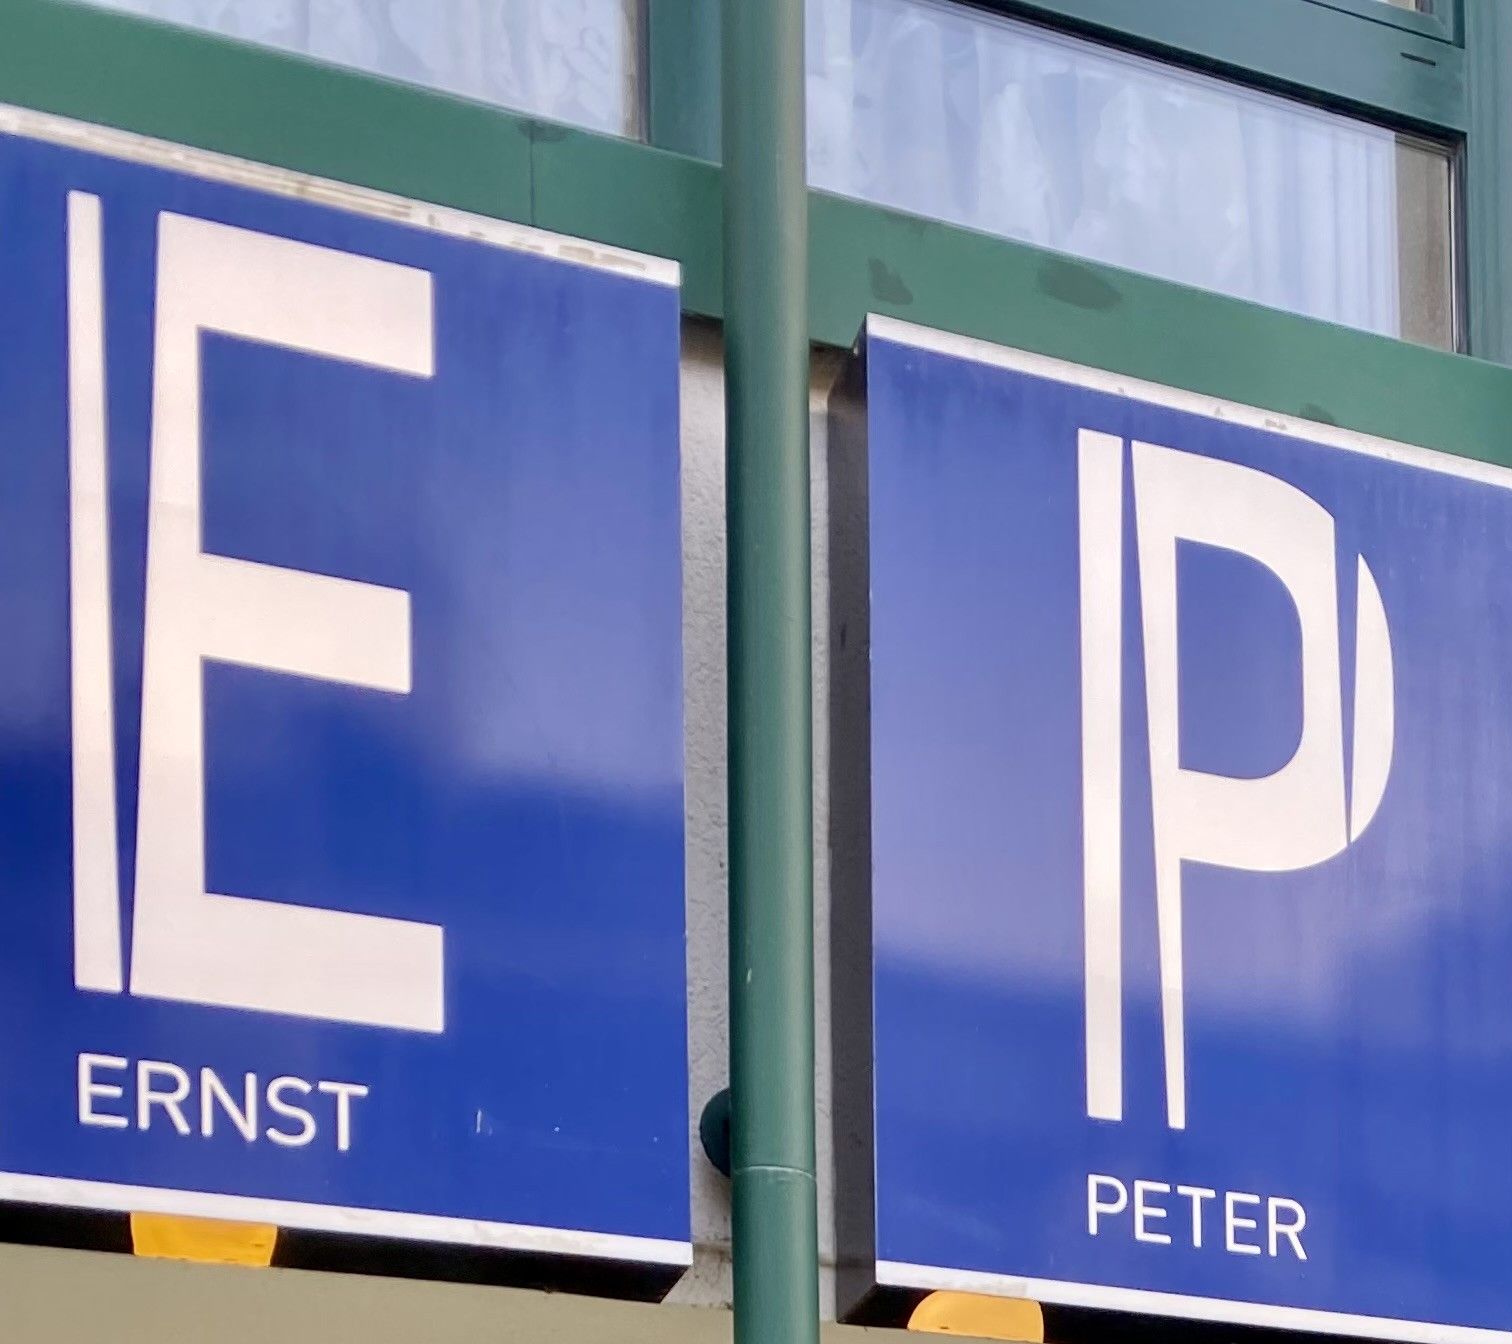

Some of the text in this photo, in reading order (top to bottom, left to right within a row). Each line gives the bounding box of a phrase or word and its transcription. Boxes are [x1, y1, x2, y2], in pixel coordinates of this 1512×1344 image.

[67, 190, 444, 1034] E
[1078, 427, 1394, 1129] P
[76, 1051, 368, 1152] ERNST
[1087, 1173, 1308, 1261] PETER
